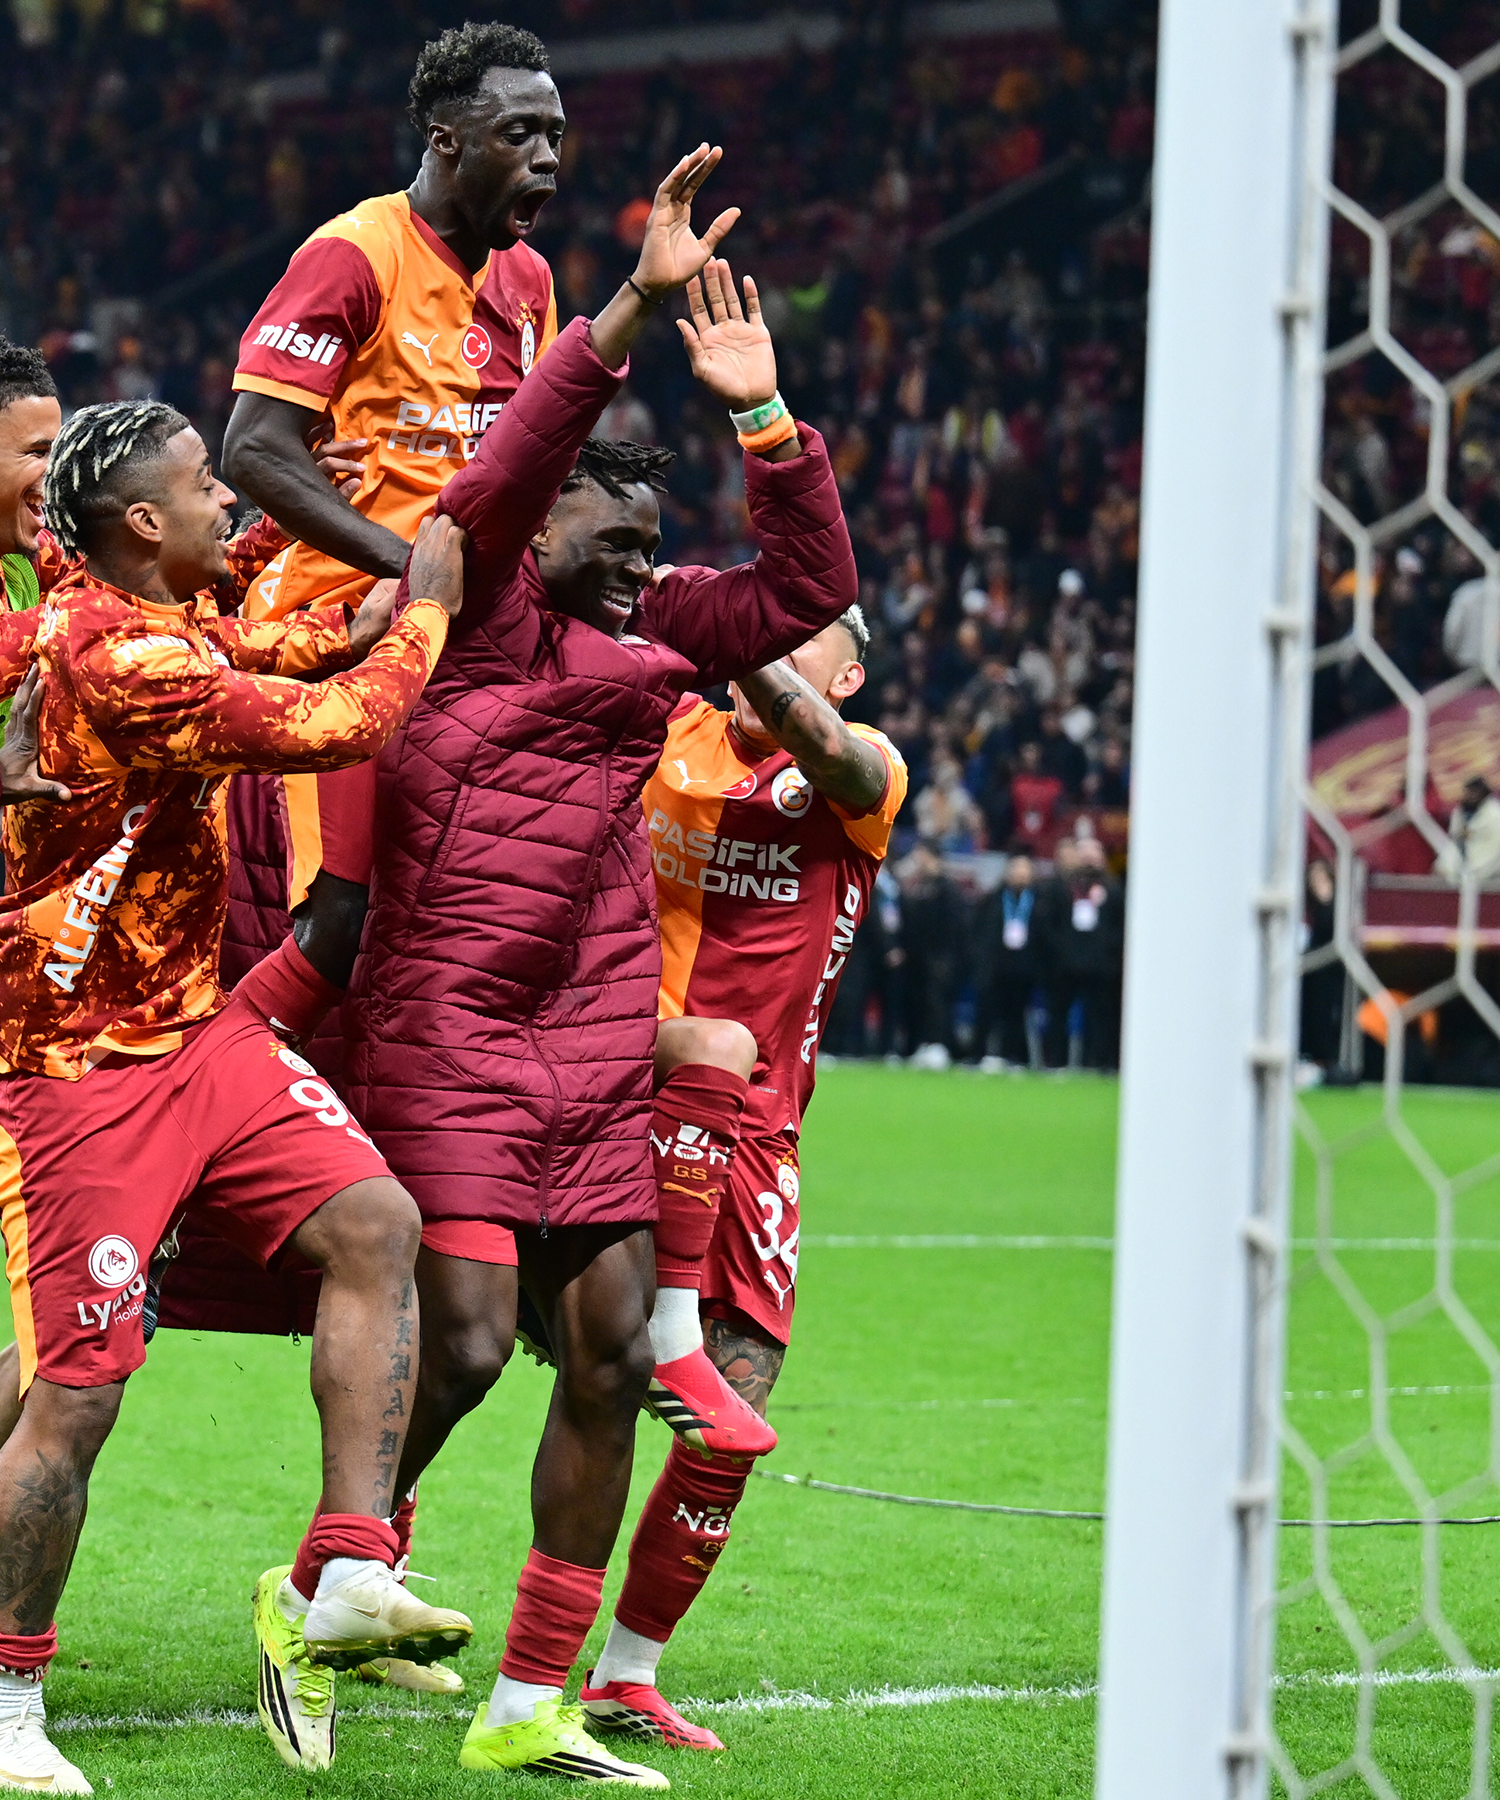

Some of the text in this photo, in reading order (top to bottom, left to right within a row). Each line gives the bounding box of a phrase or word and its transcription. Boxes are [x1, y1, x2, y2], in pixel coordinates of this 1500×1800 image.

[252, 321, 342, 366] misli
[395, 401, 508, 432] PASiF
[43, 804, 149, 993] ALFEMO
[288, 1078, 361, 1127] 9
[672, 1164, 708, 1181] GS
[672, 1502, 731, 1536] NG
